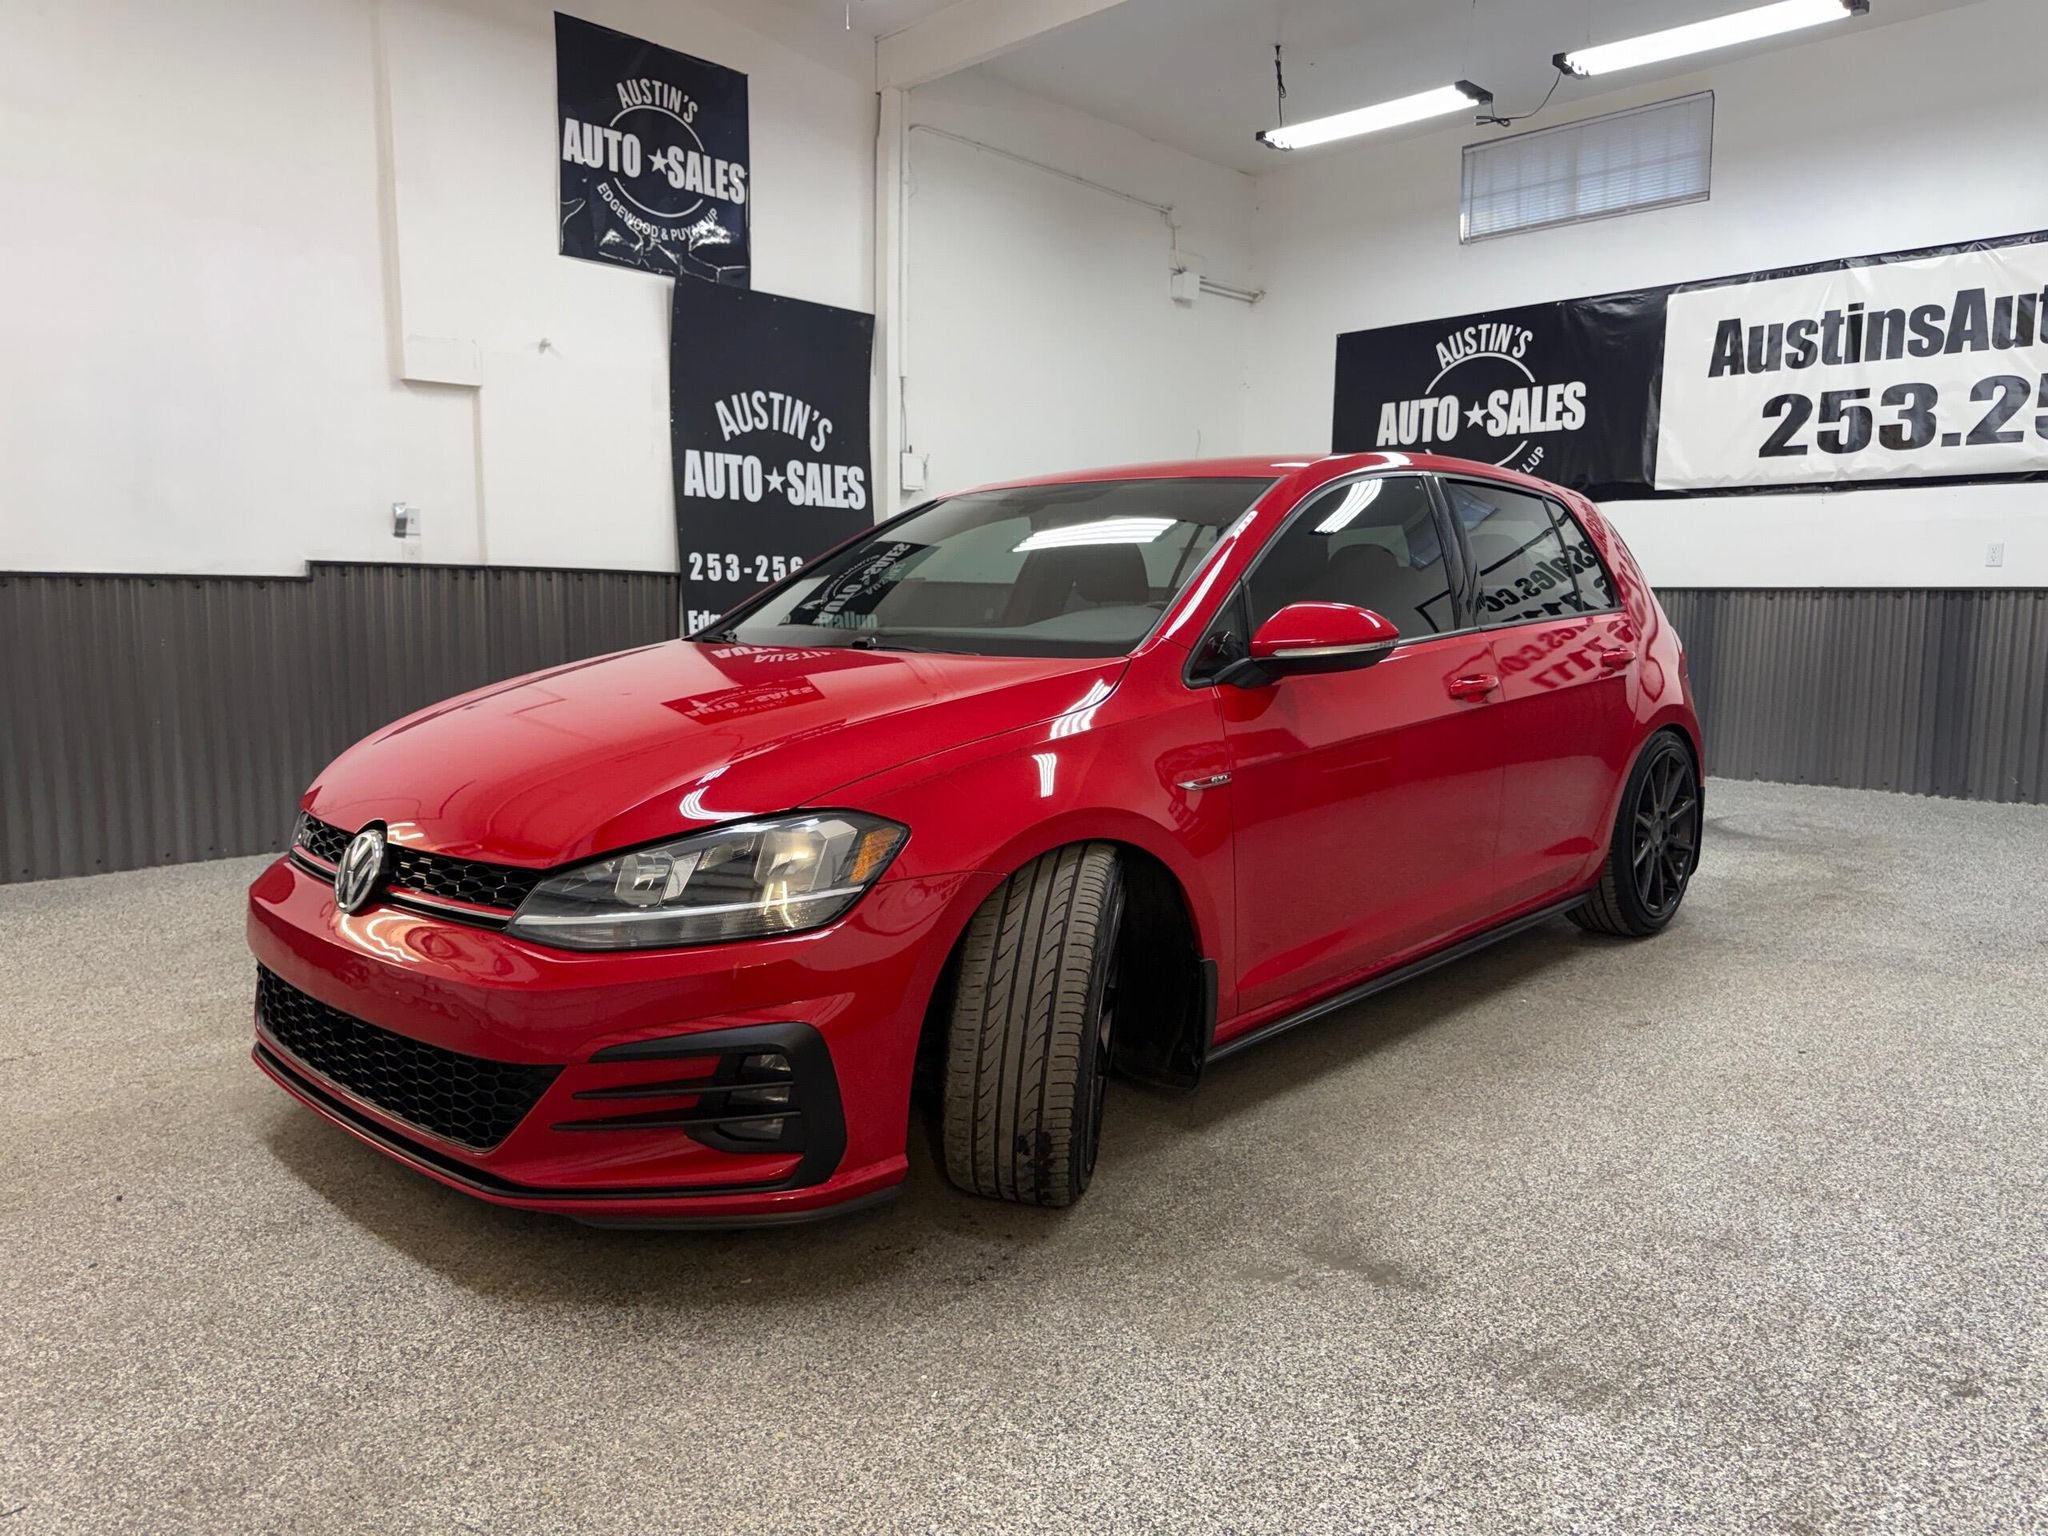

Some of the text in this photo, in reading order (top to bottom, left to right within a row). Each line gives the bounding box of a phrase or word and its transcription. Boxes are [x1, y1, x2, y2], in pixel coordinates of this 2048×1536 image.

[616, 78, 698, 124] AUSTIN'S
[563, 117, 746, 205] AUTO SALES
[597, 182, 659, 238] EDGEWOOD
[661, 229, 669, 241] &
[1436, 323, 1533, 369] AUSTIN'S
[714, 390, 833, 452] AUSTIN'S
[1376, 381, 1587, 446] AUTO SALES
[1758, 373, 2048, 457] 253.2
[684, 449, 866, 510] AUTO SALES
